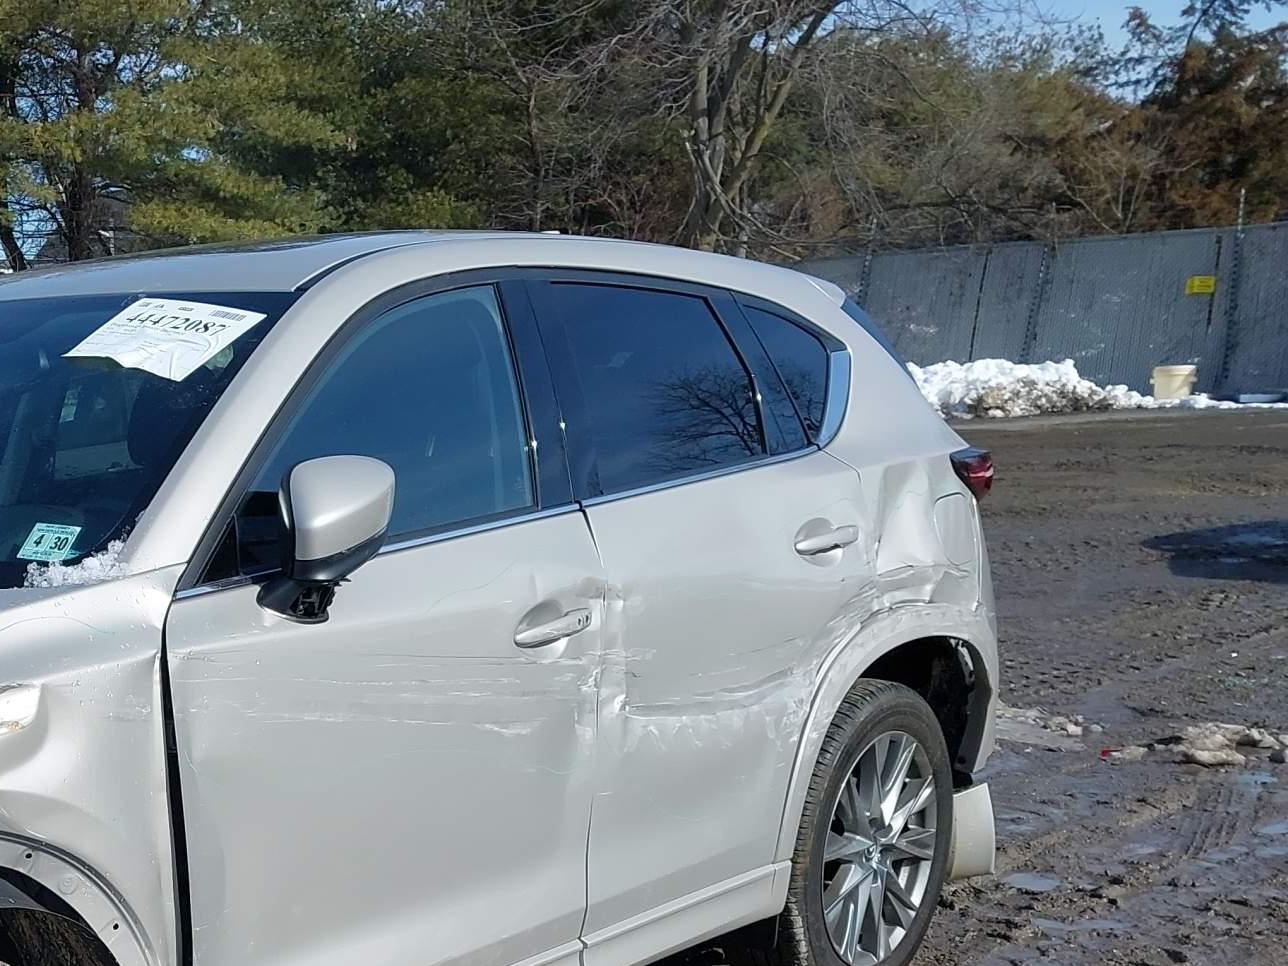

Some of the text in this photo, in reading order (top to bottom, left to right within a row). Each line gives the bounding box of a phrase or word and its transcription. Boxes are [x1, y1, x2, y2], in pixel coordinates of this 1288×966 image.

[126, 312, 231, 337] 44472087
[33, 534, 69, 551] 4 30
